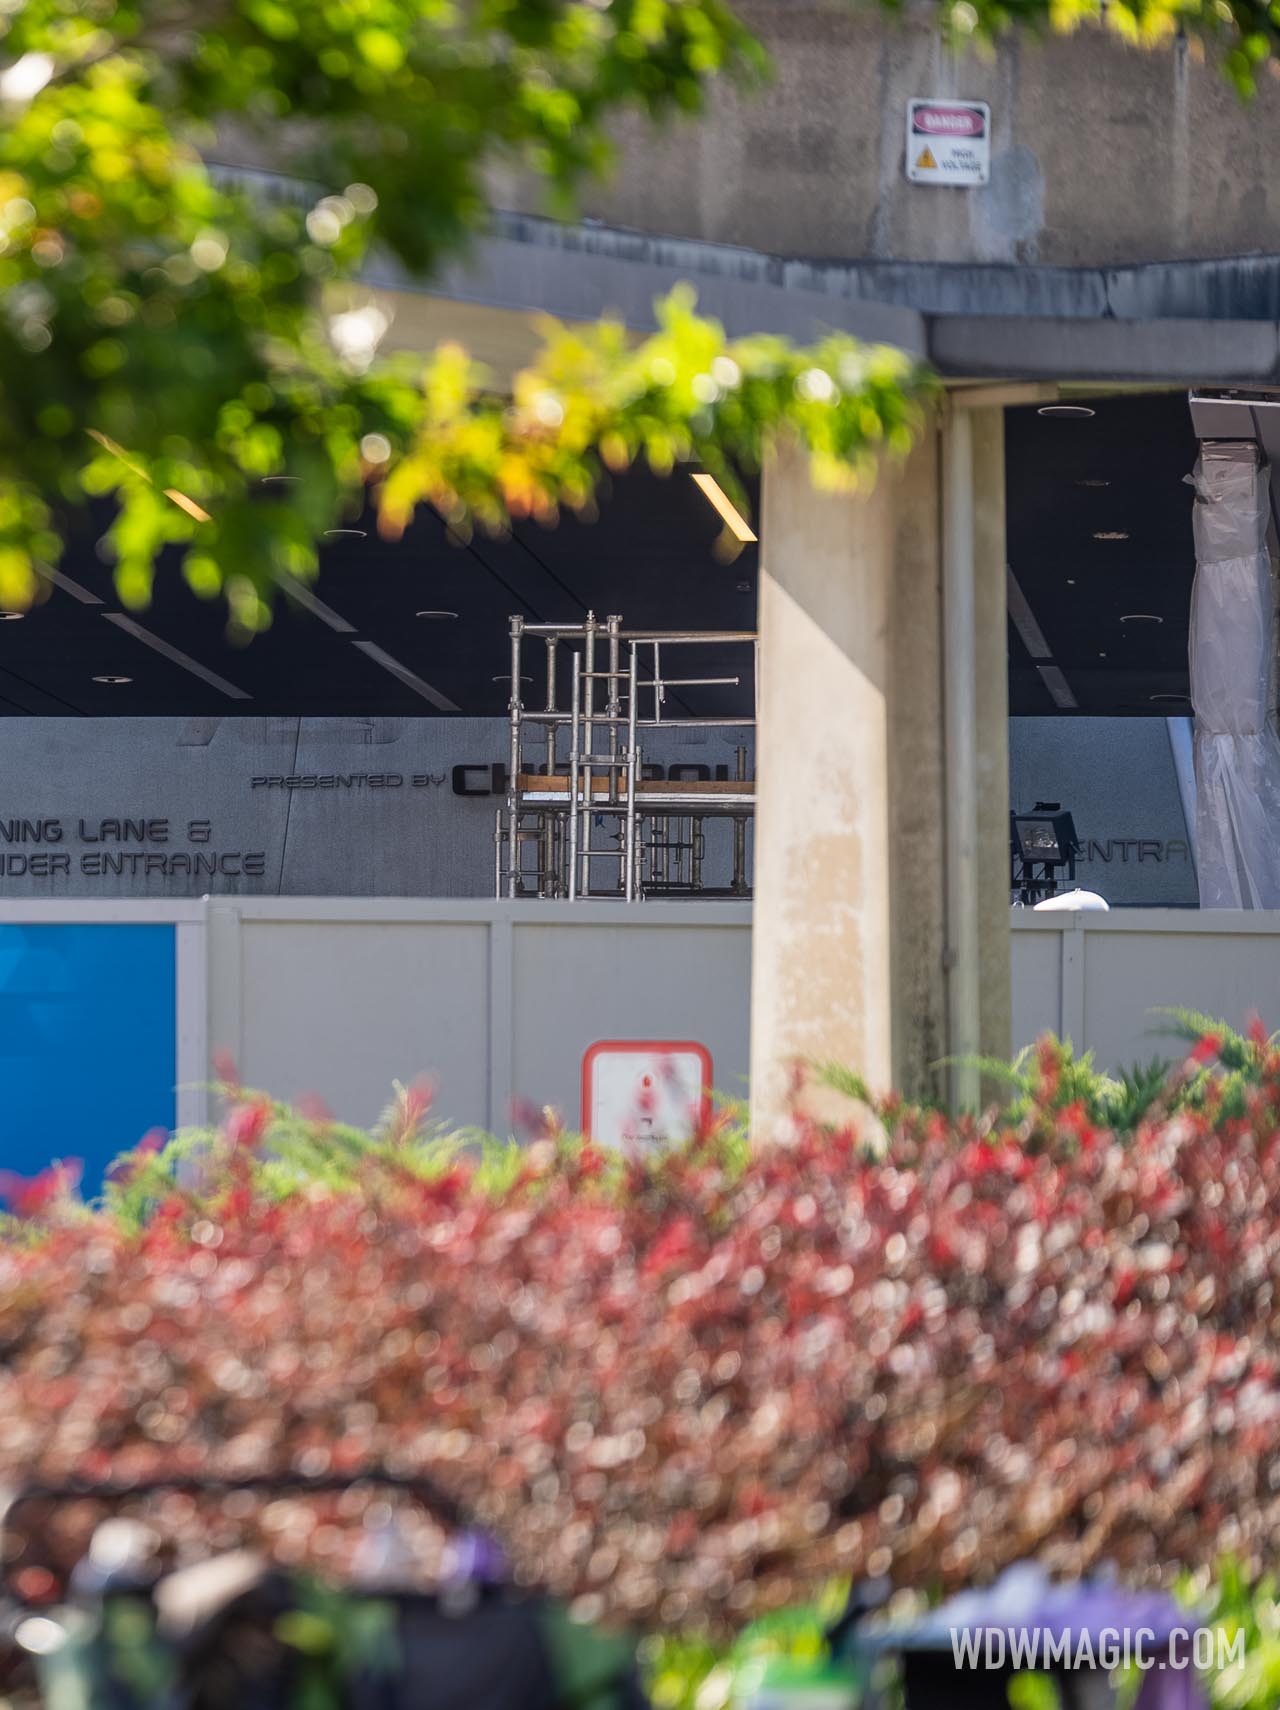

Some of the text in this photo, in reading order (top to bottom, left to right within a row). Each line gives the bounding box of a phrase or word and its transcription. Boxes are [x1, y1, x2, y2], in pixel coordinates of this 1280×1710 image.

[250, 773, 403, 789] PRESENTED
[411, 773, 446, 787] BY
[78, 818, 169, 842] LANE
[187, 818, 212, 842] &
[80, 851, 266, 876] ENTRANCE
